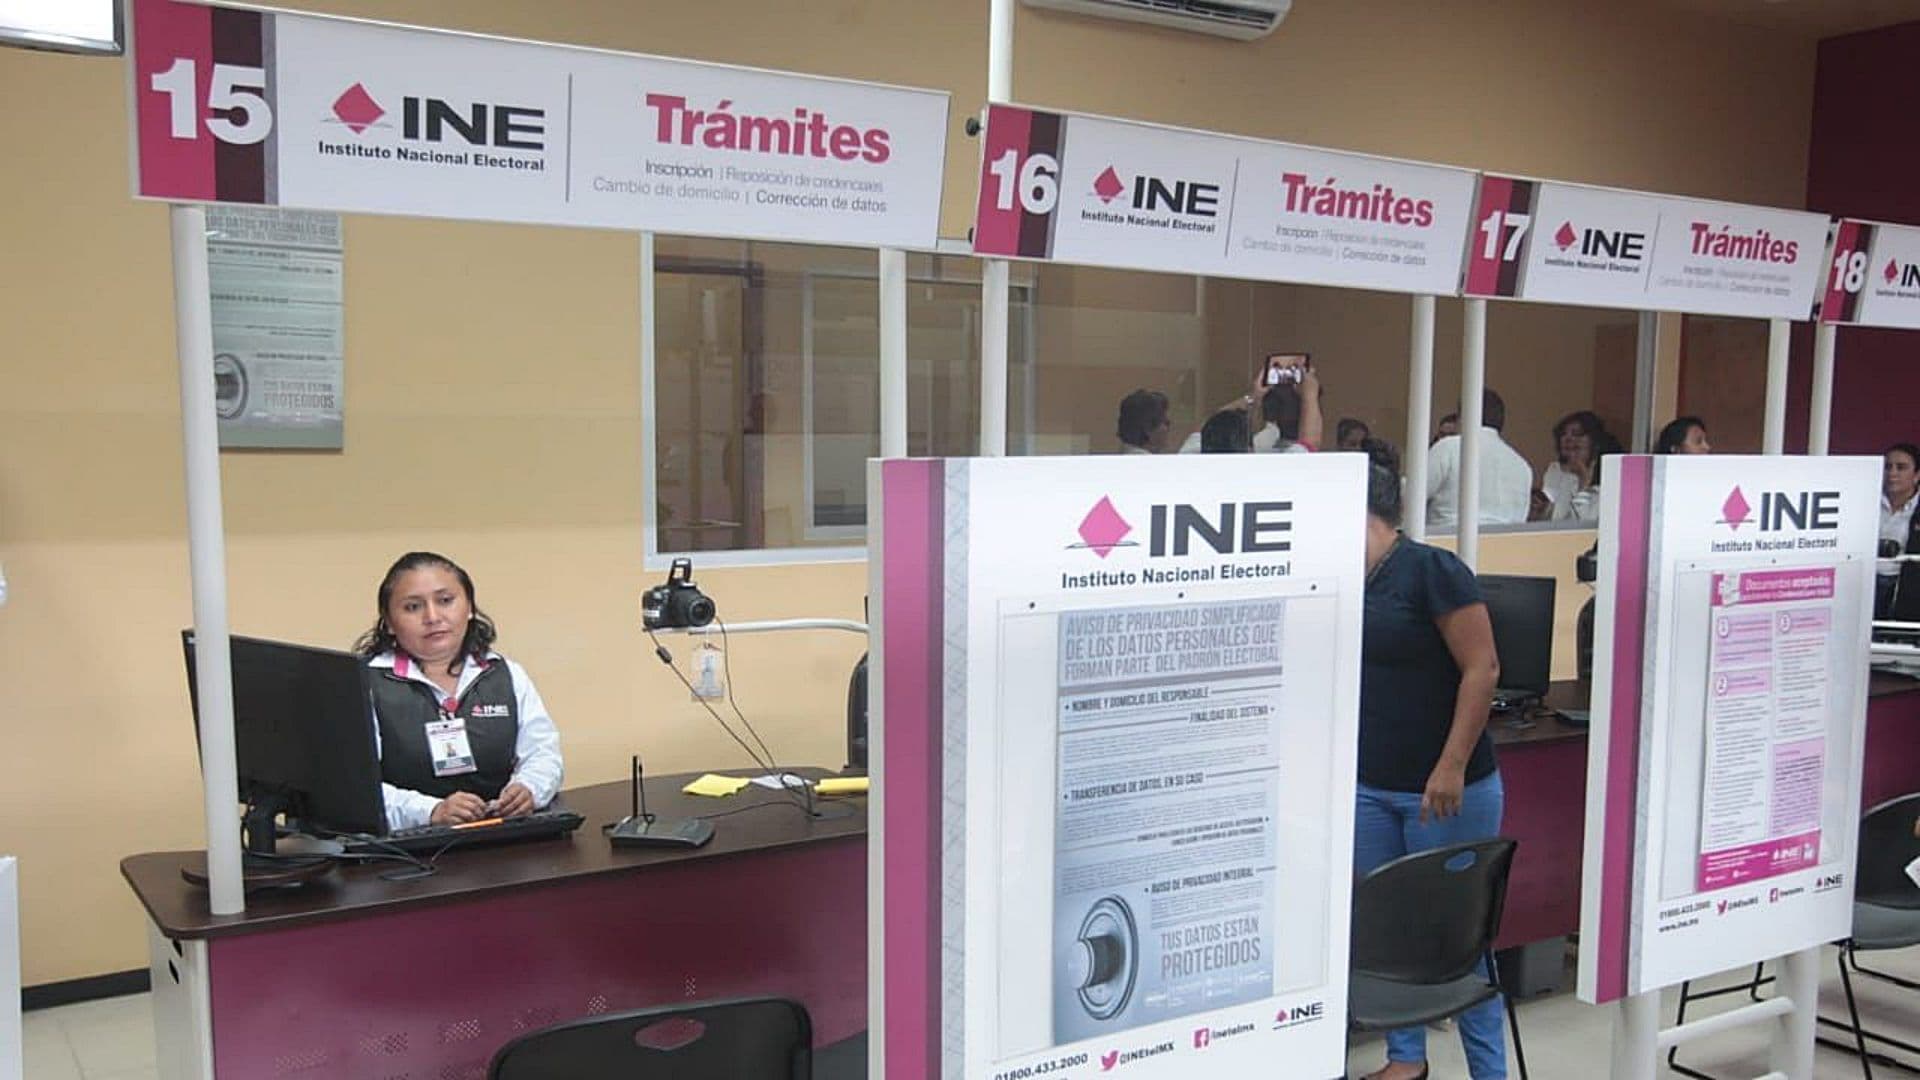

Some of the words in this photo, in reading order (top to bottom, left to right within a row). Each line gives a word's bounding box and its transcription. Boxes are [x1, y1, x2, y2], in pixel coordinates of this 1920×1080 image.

[151, 57, 272, 145] 15
[402, 96, 545, 150] INE
[646, 93, 890, 164] Trámites
[318, 141, 392, 158] Instituto
[396, 147, 468, 166] Nacional
[474, 153, 544, 171] Electoral
[593, 177, 650, 195] Cambio
[654, 182, 674, 197] de
[677, 184, 740, 201] domicilio
[645, 160, 713, 179] Inscripción
[726, 168, 792, 188] Reposición
[795, 174, 811, 187] de
[990, 149, 1059, 215] 16
[756, 190, 828, 208] Corrección
[832, 195, 848, 210] de
[851, 197, 886, 213] datos
[1132, 175, 1219, 216] INE
[1282, 173, 1433, 227] Trámites
[1081, 210, 1124, 223] Instituto
[1127, 215, 1169, 228] Nacional
[1172, 219, 1215, 233] Electoral
[1480, 210, 1530, 262] 17
[1581, 228, 1645, 260] INE
[1691, 222, 1798, 264] Trámites
[1834, 250, 1867, 293] 18
[1760, 491, 1840, 531] INE
[1149, 501, 1293, 557] INE
[1711, 539, 1752, 552] Instituto
[1755, 538, 1795, 551] Nacional
[1797, 536, 1837, 549] Electoral
[1062, 571, 1136, 589] Instituto
[1142, 565, 1215, 585] Nacional
[1220, 561, 1291, 579] Electoral
[1066, 615, 1104, 636] AVISO
[1107, 614, 1123, 633] DE
[1126, 608, 1198, 632] PRIVACIDAD
[1199, 603, 1281, 627] SIMPLIFICADO
[1065, 638, 1083, 660] DE
[1088, 636, 1114, 657] LOS
[1118, 632, 1162, 655] DATOS
[1165, 626, 1249, 651] PERSONALES
[1252, 623, 1277, 644] QUE
[1064, 659, 1113, 681] FORMAN
[1115, 656, 1150, 676] PARTE
[1155, 655, 1176, 672] DEL
[1223, 646, 1279, 666] ELECTORAL
[1824, 874, 1843, 887] INE
[1161, 931, 1184, 950] TUS
[1185, 924, 1221, 946] DATOS
[1162, 938, 1261, 980] PROTEGIDOS
[1290, 1001, 1324, 1021] INE
[994, 1053, 1089, 1080] 01800.433.2000
